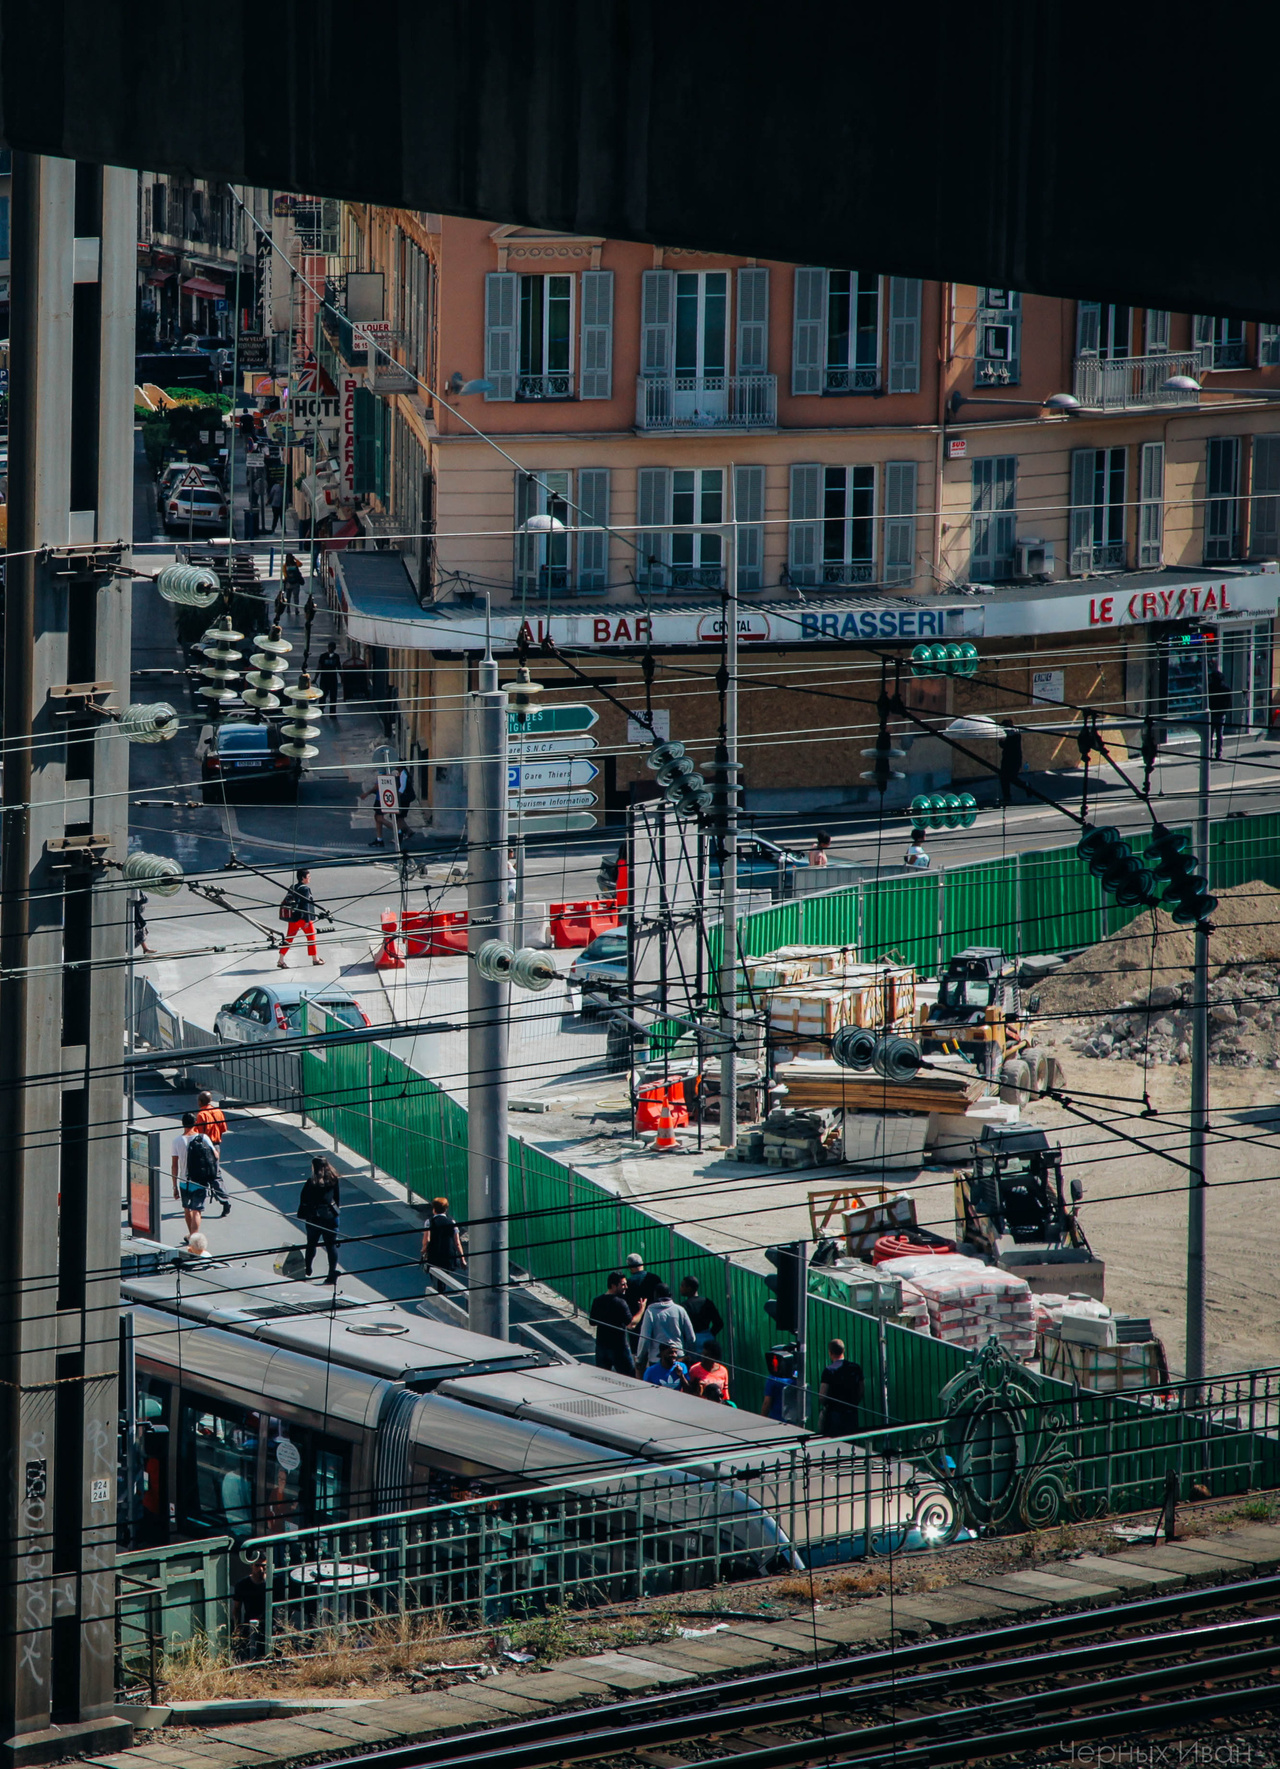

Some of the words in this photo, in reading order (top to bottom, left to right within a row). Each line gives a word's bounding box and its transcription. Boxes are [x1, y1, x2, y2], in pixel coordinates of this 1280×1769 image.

[362, 323, 390, 332] LOUER
[345, 380, 356, 490] BACCARAT
[1090, 597, 1114, 624] LE
[1128, 584, 1230, 619] CRYSTAL
[593, 618, 652, 643] BAR
[801, 610, 963, 638] BRASSERI
[524, 772, 543, 780] Gare
[548, 770, 571, 778] Thiers
[385, 794, 392, 803] 30
[516, 799, 547, 808] Tourisme
[549, 796, 590, 806] Information
